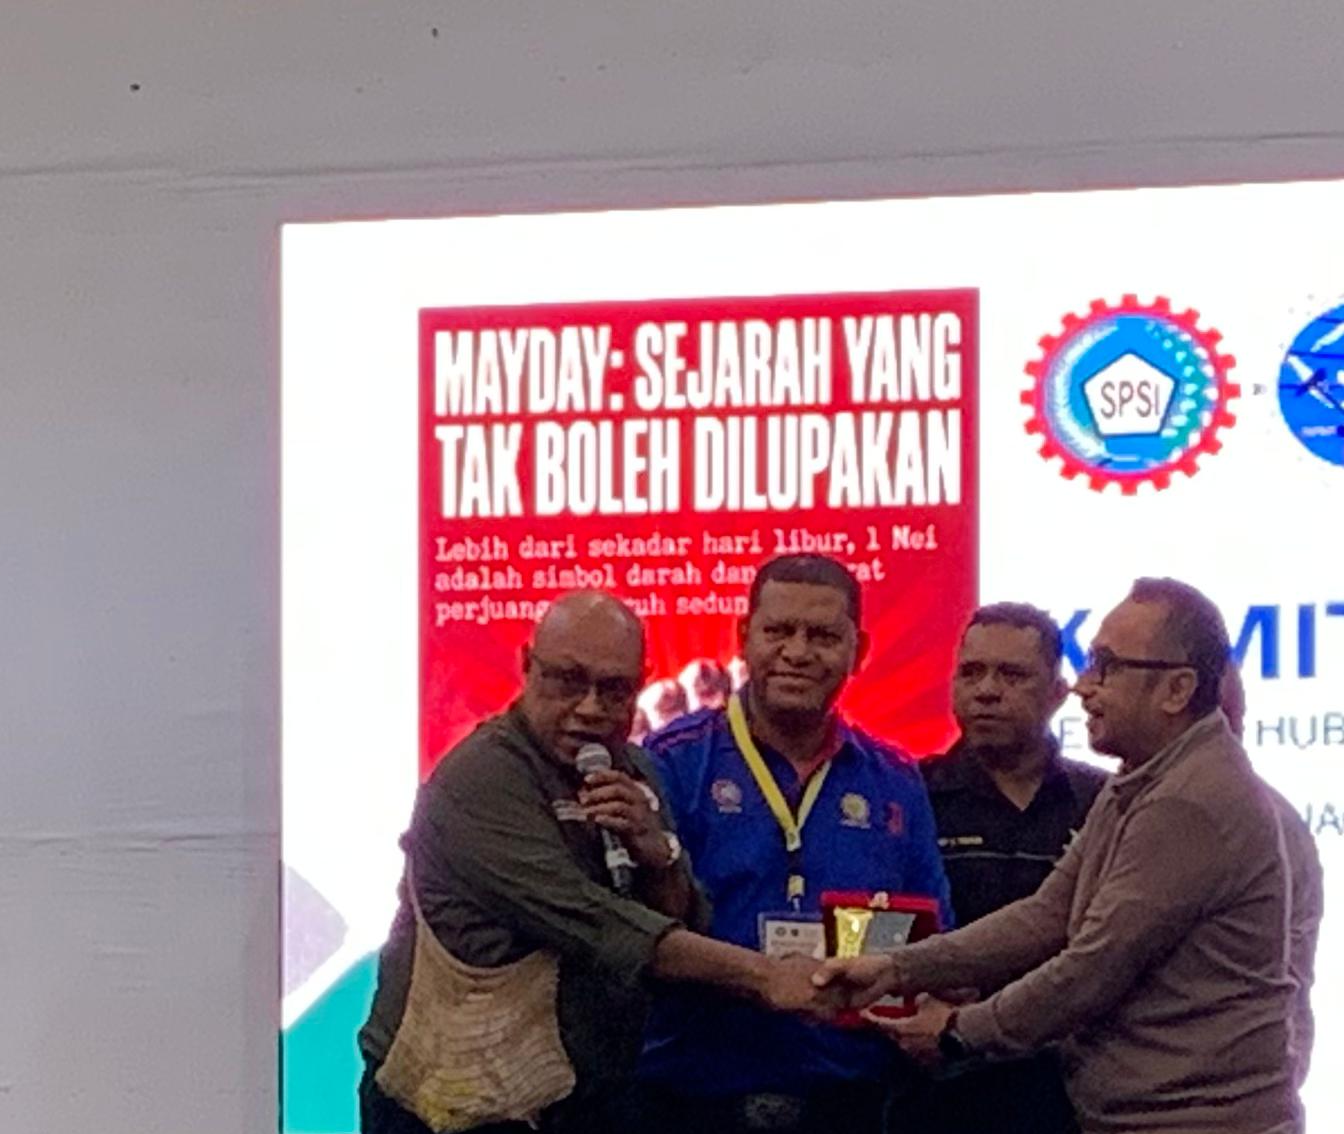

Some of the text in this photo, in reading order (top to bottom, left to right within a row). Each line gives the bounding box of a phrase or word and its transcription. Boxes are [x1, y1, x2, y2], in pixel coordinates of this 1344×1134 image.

[434, 312, 962, 417] MAYDAY: SEJARAH YANG
[1100, 379, 1161, 419] SPSI
[434, 408, 962, 519] TAK BOLEH DILUPAKAN
[435, 534, 509, 562] Lebih
[518, 533, 578, 560] dari
[588, 531, 693, 558] sekadar
[702, 528, 764, 555] hari
[772, 527, 856, 556] libur,
[435, 559, 758, 592] adalah simbol darah dan
[435, 594, 551, 628] perjuang
[675, 589, 749, 617] sedun
